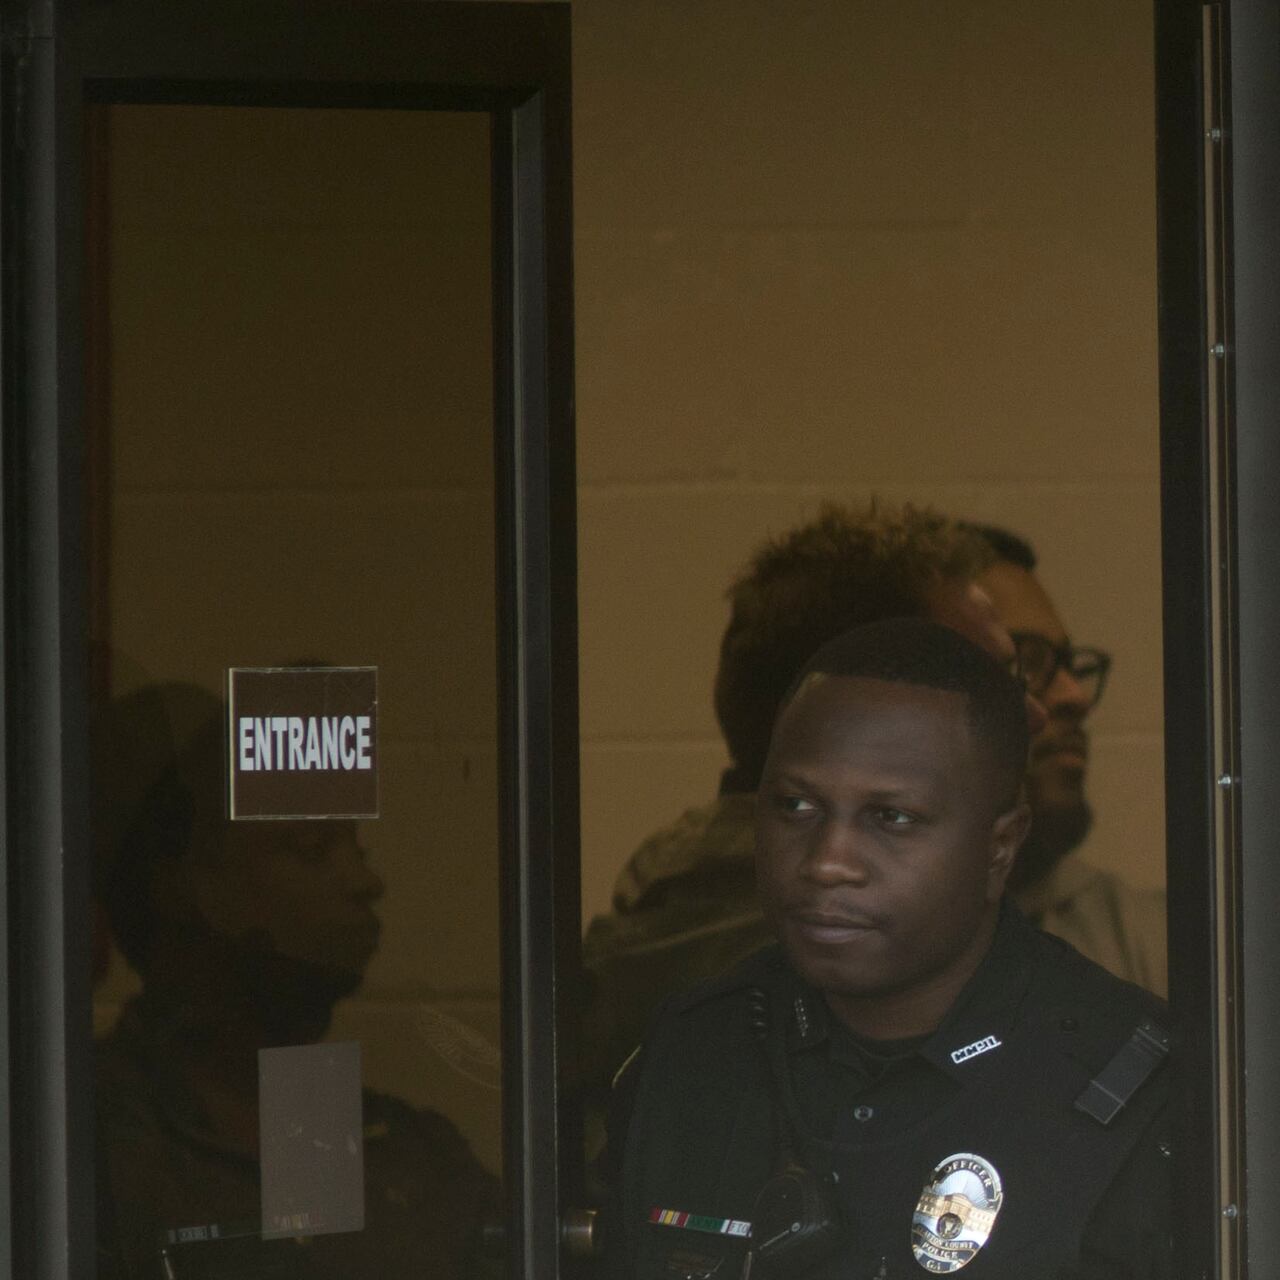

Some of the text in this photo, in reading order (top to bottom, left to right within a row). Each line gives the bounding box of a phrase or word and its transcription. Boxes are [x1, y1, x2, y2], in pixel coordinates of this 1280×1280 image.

[239, 715, 371, 771] ENTRANCE
[943, 1160, 992, 1187] OFFICER
[921, 1242, 959, 1260] POLICE
